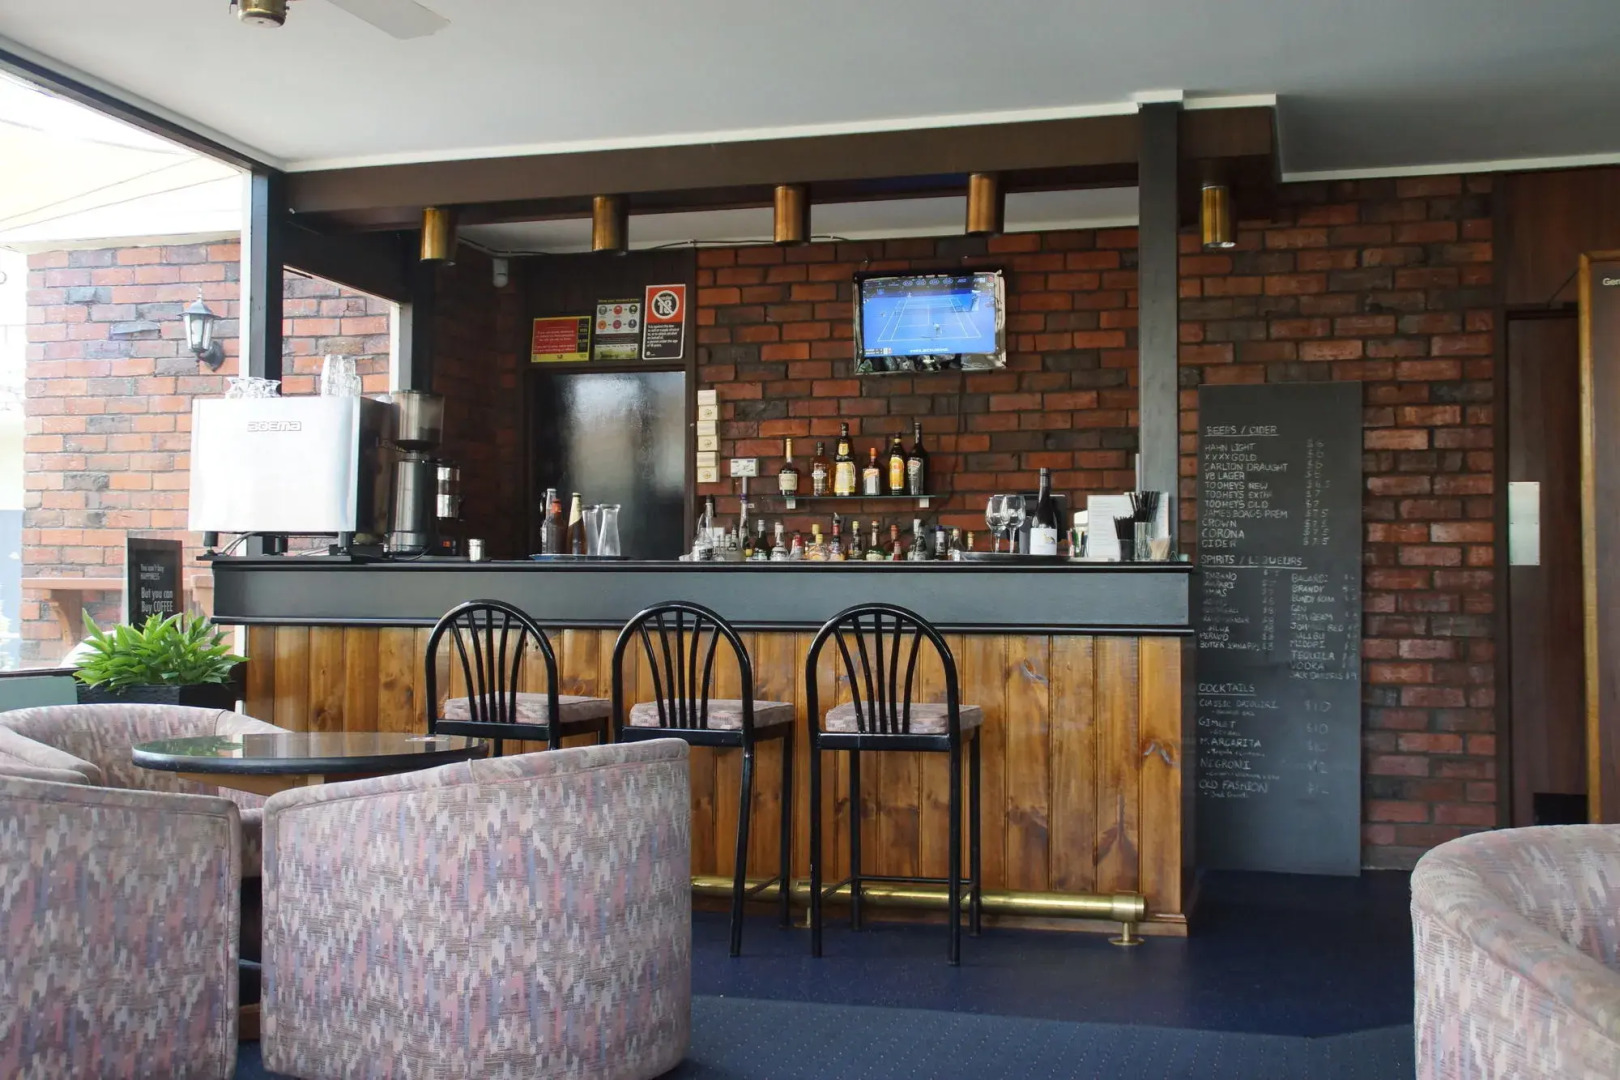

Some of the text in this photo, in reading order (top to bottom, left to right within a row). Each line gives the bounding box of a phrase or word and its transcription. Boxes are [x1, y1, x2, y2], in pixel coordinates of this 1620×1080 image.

[658, 300, 672, 314] 18
[1206, 425, 1237, 435] BEERS
[1250, 425, 1278, 435] CIDER
[1204, 443, 1228, 452] HAHN
[1231, 442, 1256, 452] LIGHT
[1231, 453, 1257, 462] GOLD
[1204, 463, 1243, 472] CARLTON
[1247, 463, 1288, 472] DRAUGHT
[1205, 472, 1215, 480] VB
[1218, 472, 1245, 480] LAGER
[1205, 481, 1245, 490] TOOHEYS
[1248, 482, 1268, 490] NEW
[1205, 490, 1244, 499] TOOHEYS
[1204, 499, 1245, 509] TOOHEYS
[1248, 500, 1269, 509] OLD
[1265, 509, 1288, 519] PREM
[1202, 518, 1237, 527] CROWN
[1202, 528, 1245, 539] CORONA
[1202, 539, 1237, 548] CIDER
[1201, 554, 1235, 564] SPIRITS
[1292, 585, 1324, 594] BRANDY
[152, 590, 162, 600] you
[163, 590, 173, 598] can
[141, 600, 173, 614] Buy COFFEE
[1292, 651, 1335, 661] TEQUILA
[1290, 661, 1325, 670] VODKA
[1199, 683, 1255, 693] COCKTAILS
[1199, 699, 1232, 709] CLASSIC
[1198, 718, 1236, 729] GIMLET
[1200, 737, 1262, 748] MARGARITA
[1200, 758, 1251, 770] NEGRONI
[1199, 780, 1218, 789] OLD
